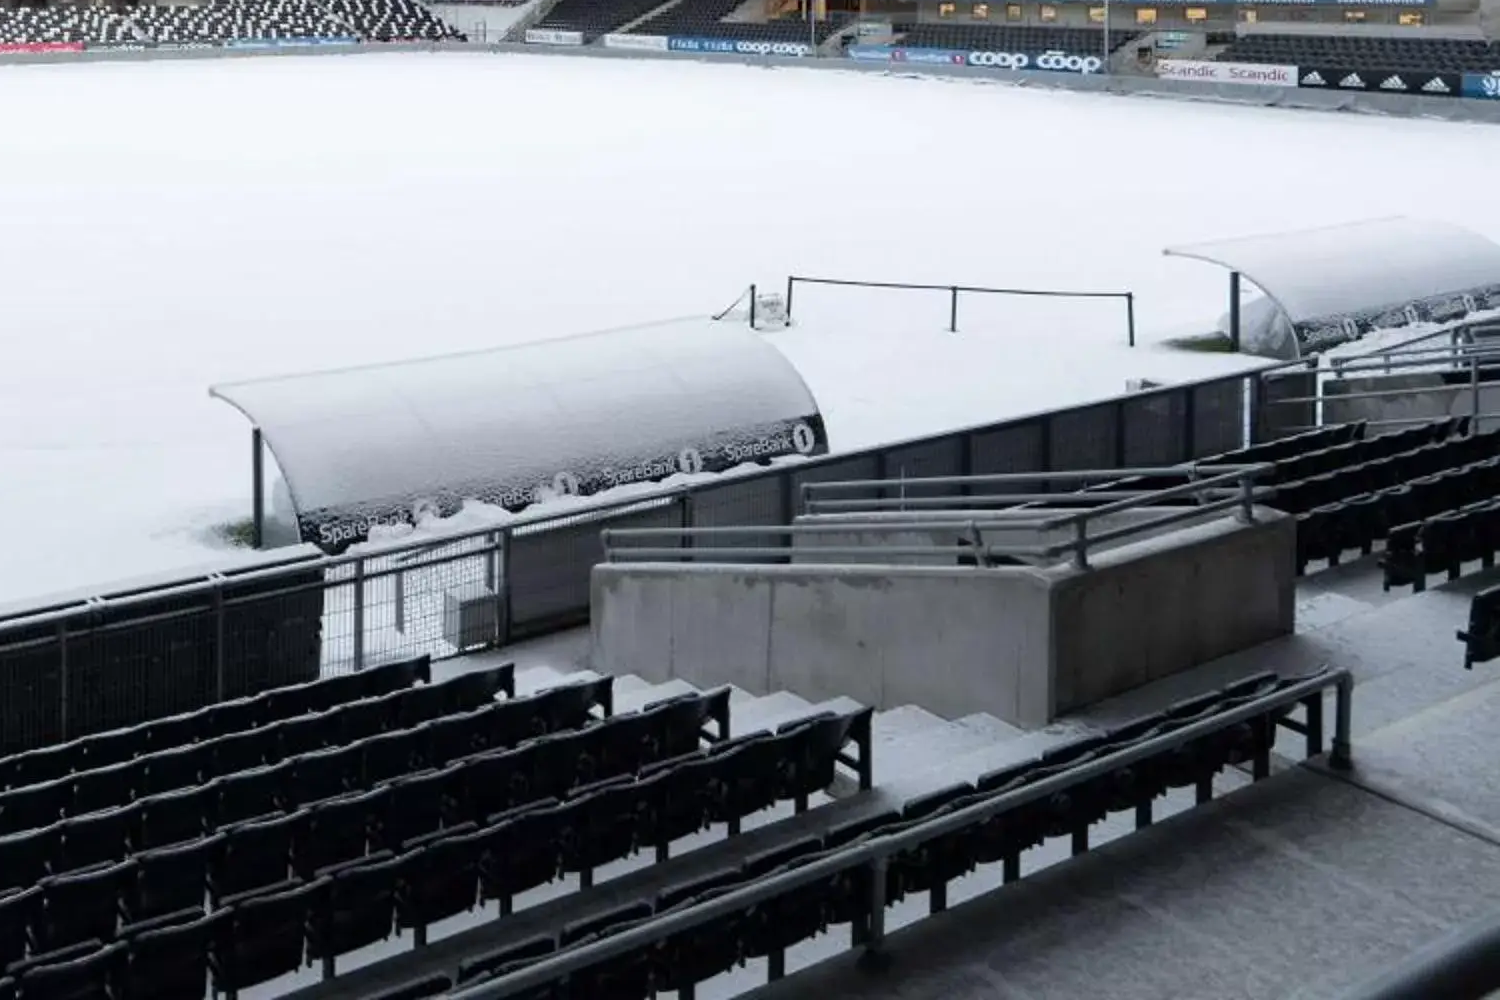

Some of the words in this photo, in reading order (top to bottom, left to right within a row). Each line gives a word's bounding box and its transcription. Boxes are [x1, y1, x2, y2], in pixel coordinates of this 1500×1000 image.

[737, 41, 770, 54] coop
[969, 52, 1028, 70] coop
[1037, 53, 1101, 75] coop
[1161, 64, 1217, 78] Scandic
[1229, 66, 1288, 81] Scandic
[725, 435, 793, 462] SpareBank
